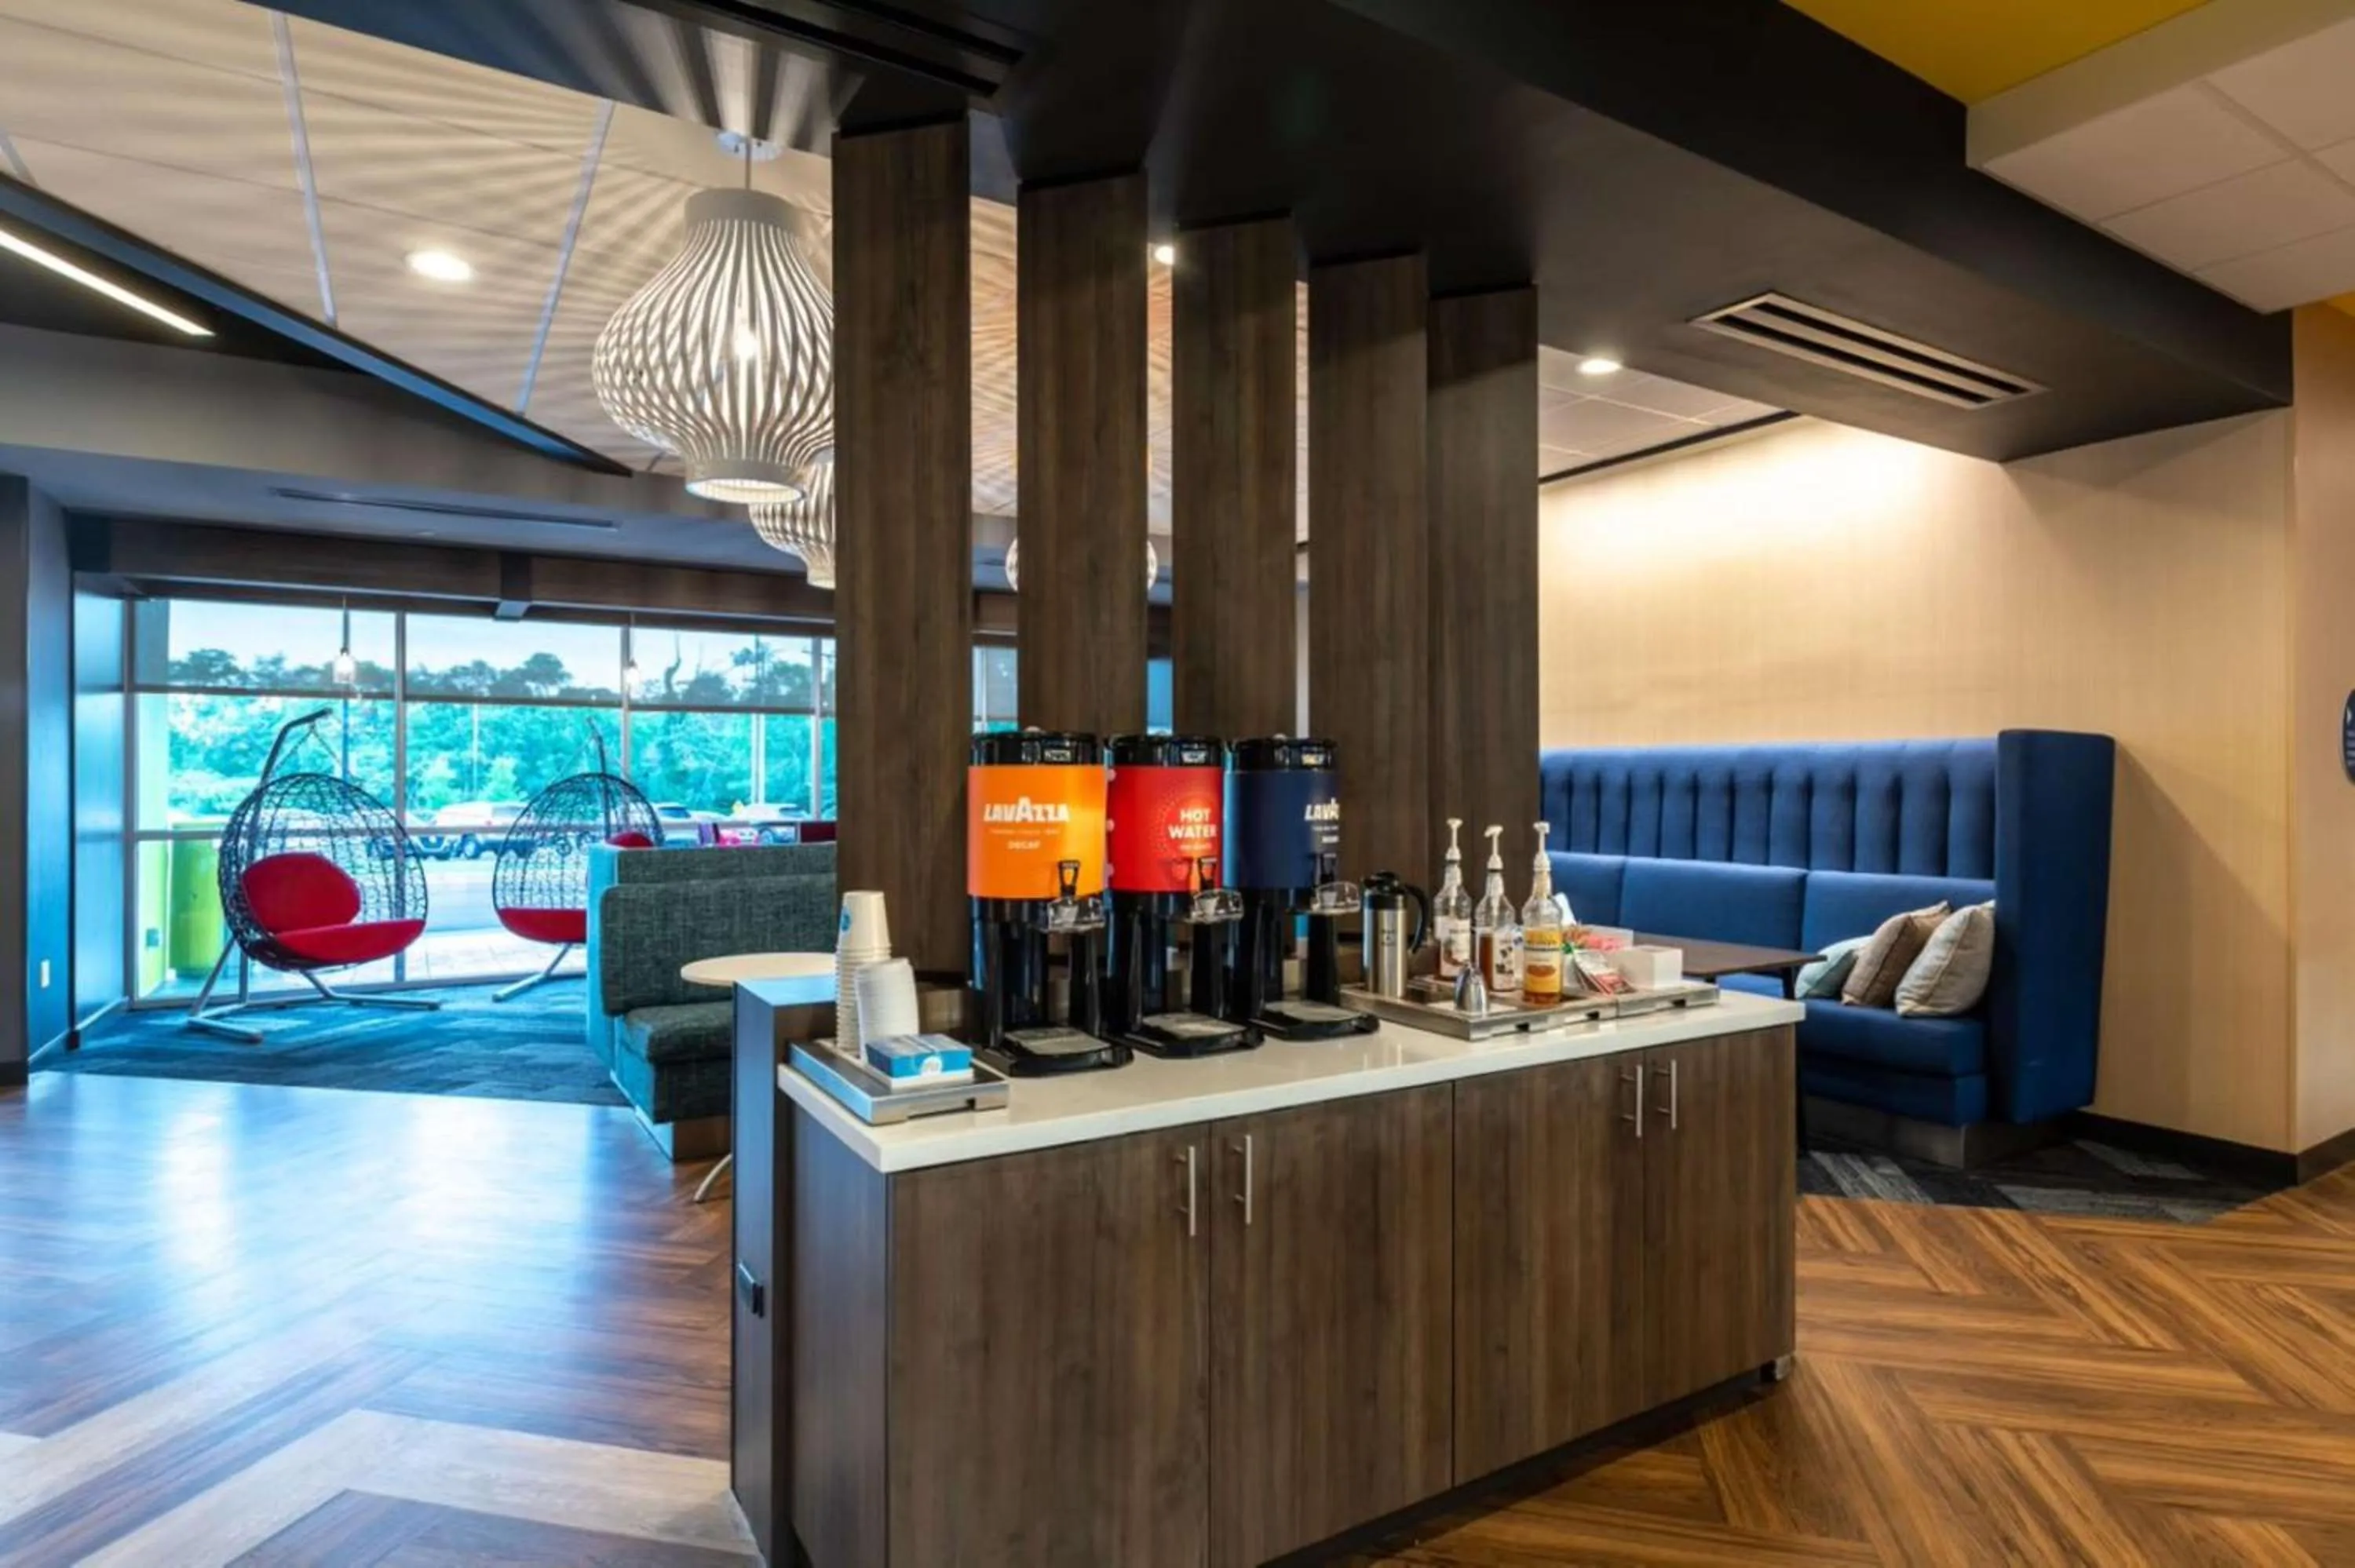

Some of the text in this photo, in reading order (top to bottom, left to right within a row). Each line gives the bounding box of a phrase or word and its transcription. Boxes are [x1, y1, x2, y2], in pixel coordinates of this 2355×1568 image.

[984, 796, 1070, 822] LAVAZZA
[1180, 808, 1211, 822] HOT
[1167, 824, 1217, 840] WATER
